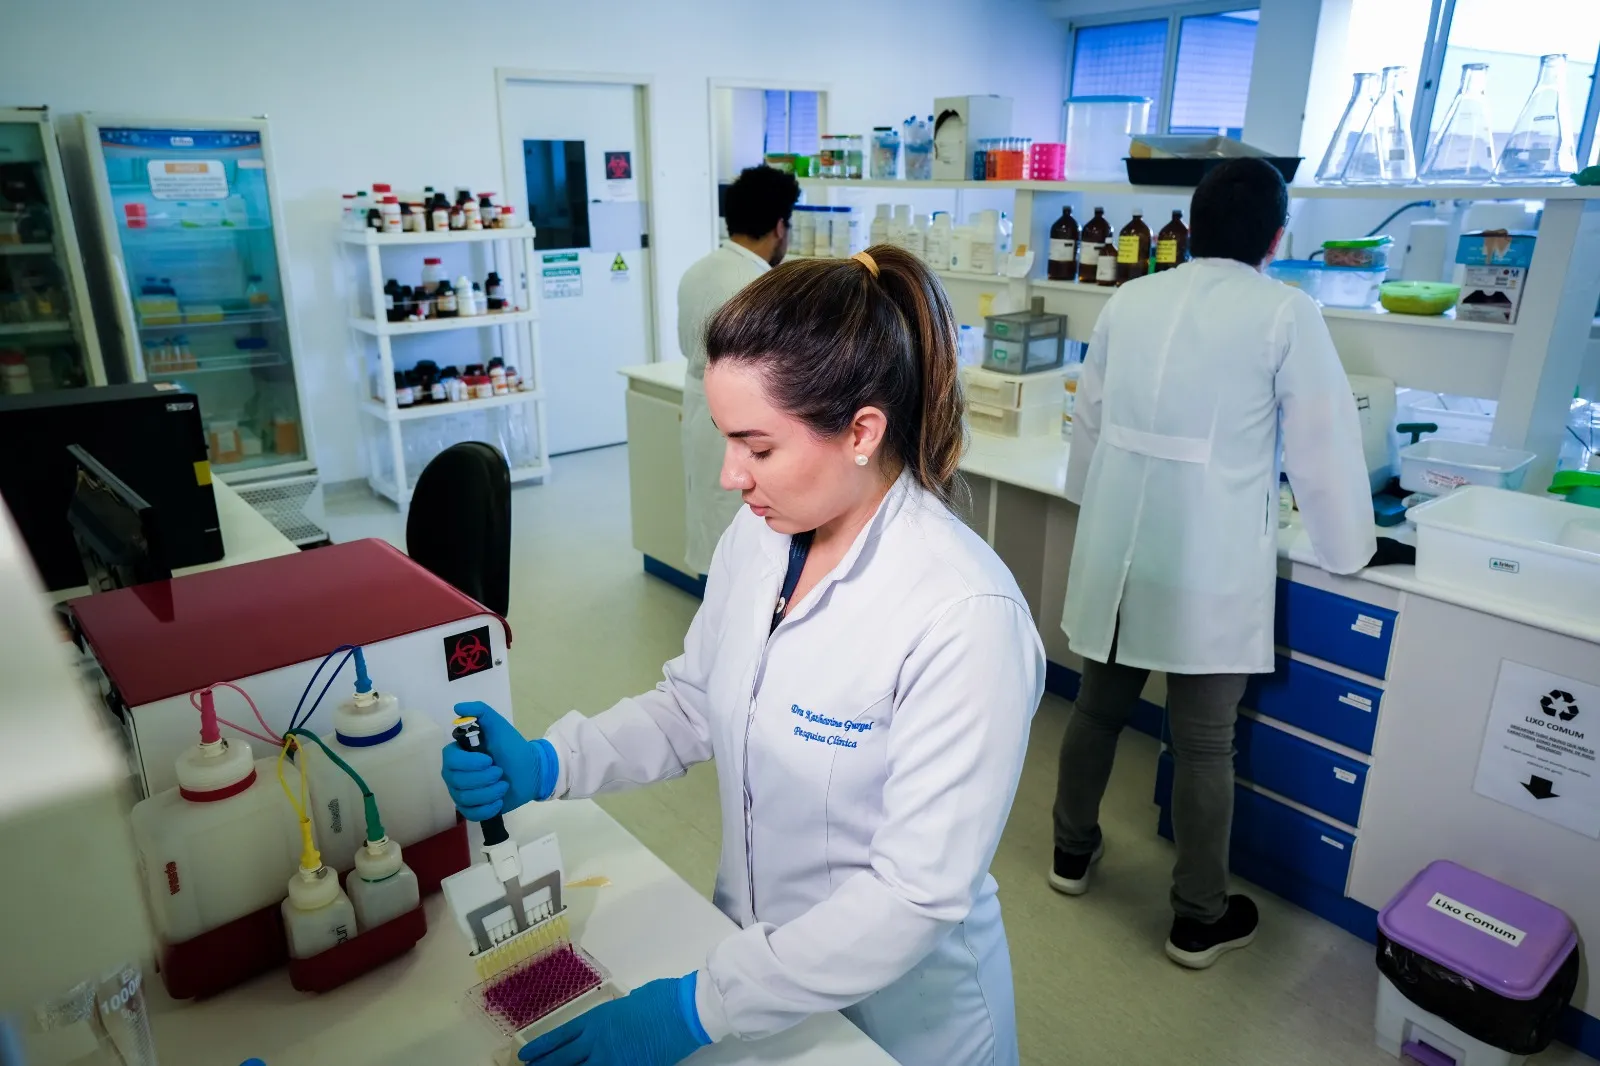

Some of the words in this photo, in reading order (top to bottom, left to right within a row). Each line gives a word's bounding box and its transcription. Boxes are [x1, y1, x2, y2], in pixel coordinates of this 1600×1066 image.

[791, 704, 804, 717] Dra
[844, 720, 875, 733] Gurgel
[1525, 716, 1545, 727] LIXO
[1546, 722, 1585, 740] COMUM
[794, 726, 826, 742] Pesquisa
[1435, 899, 1462, 915] Lixo
[1464, 912, 1517, 941] Comum
